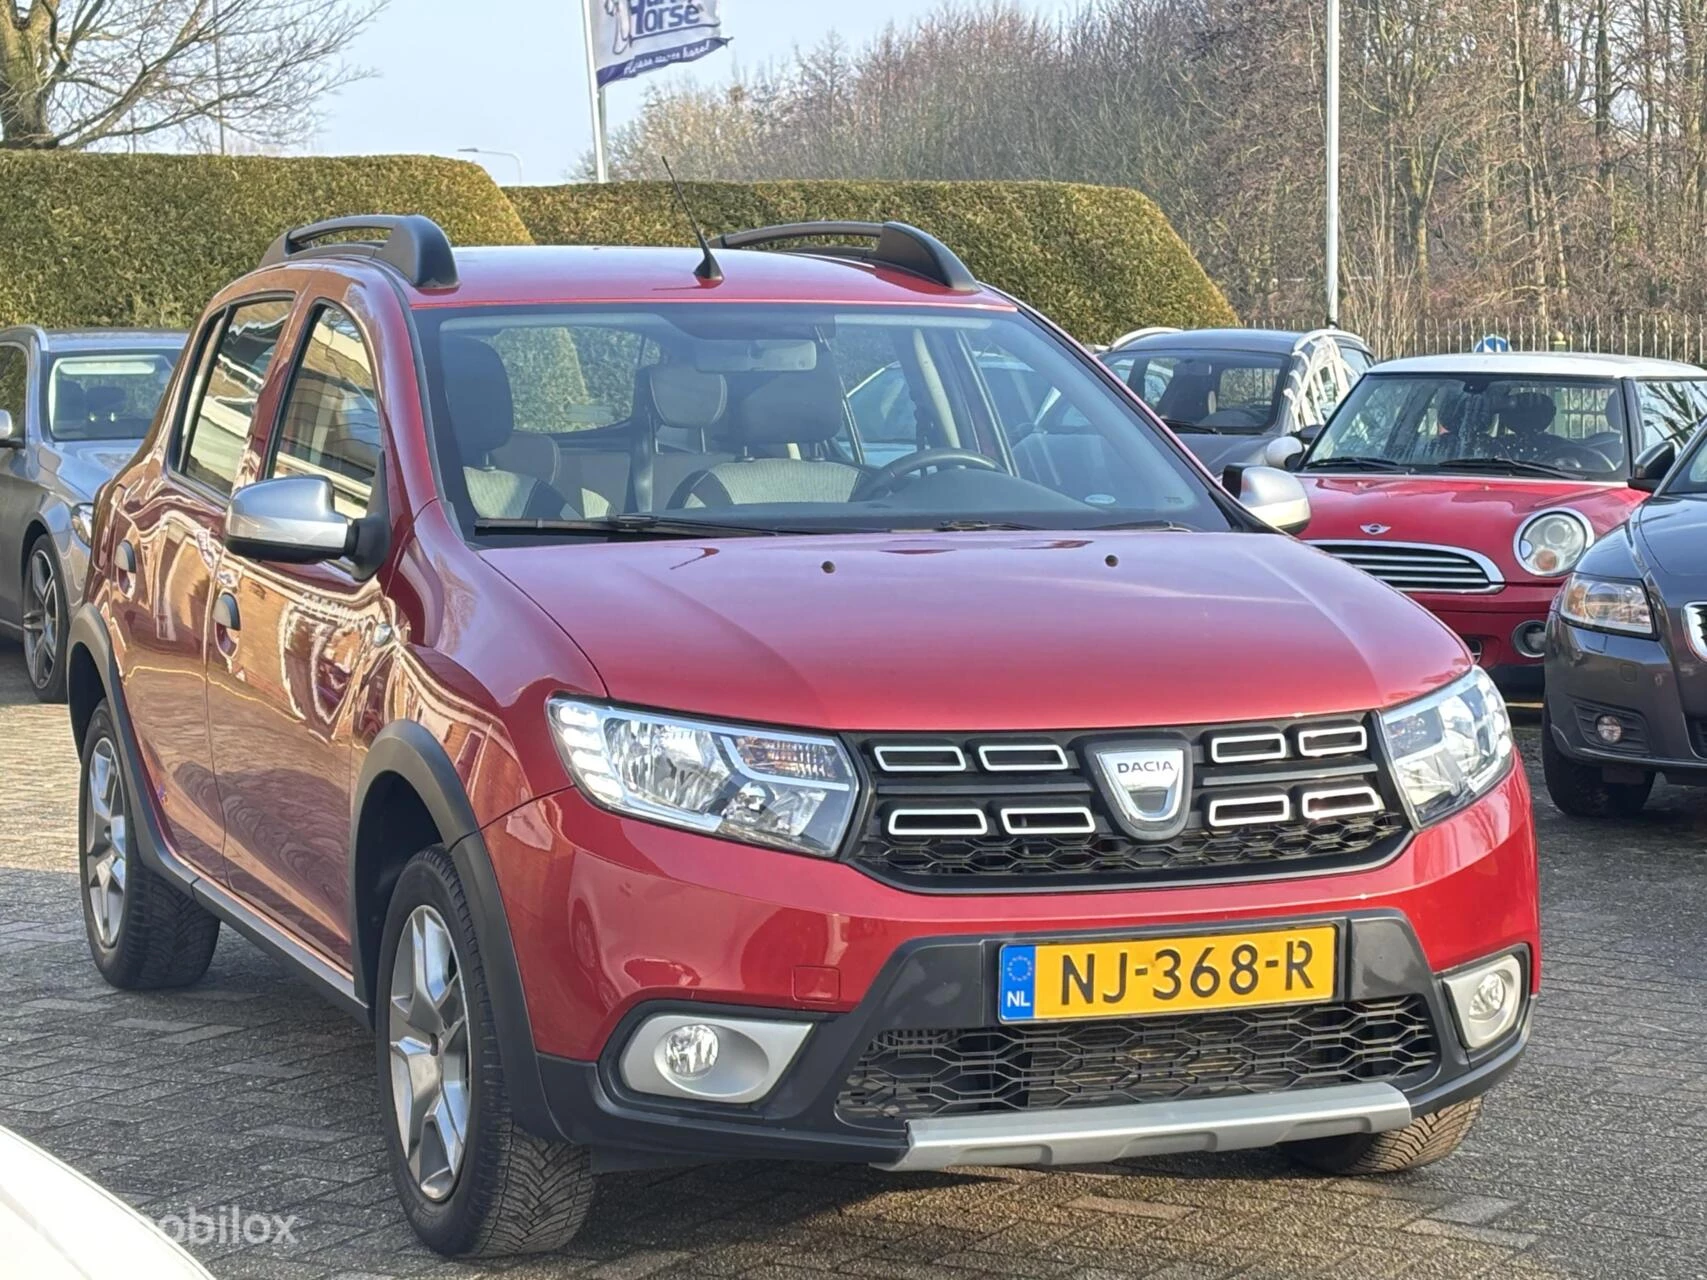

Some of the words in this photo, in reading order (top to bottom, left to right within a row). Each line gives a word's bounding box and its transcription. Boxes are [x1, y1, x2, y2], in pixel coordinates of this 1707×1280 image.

[1117, 761, 1174, 774] DACIA
[1060, 940, 1315, 1006] NJ-368-R
[1007, 991, 1031, 1008] NL
